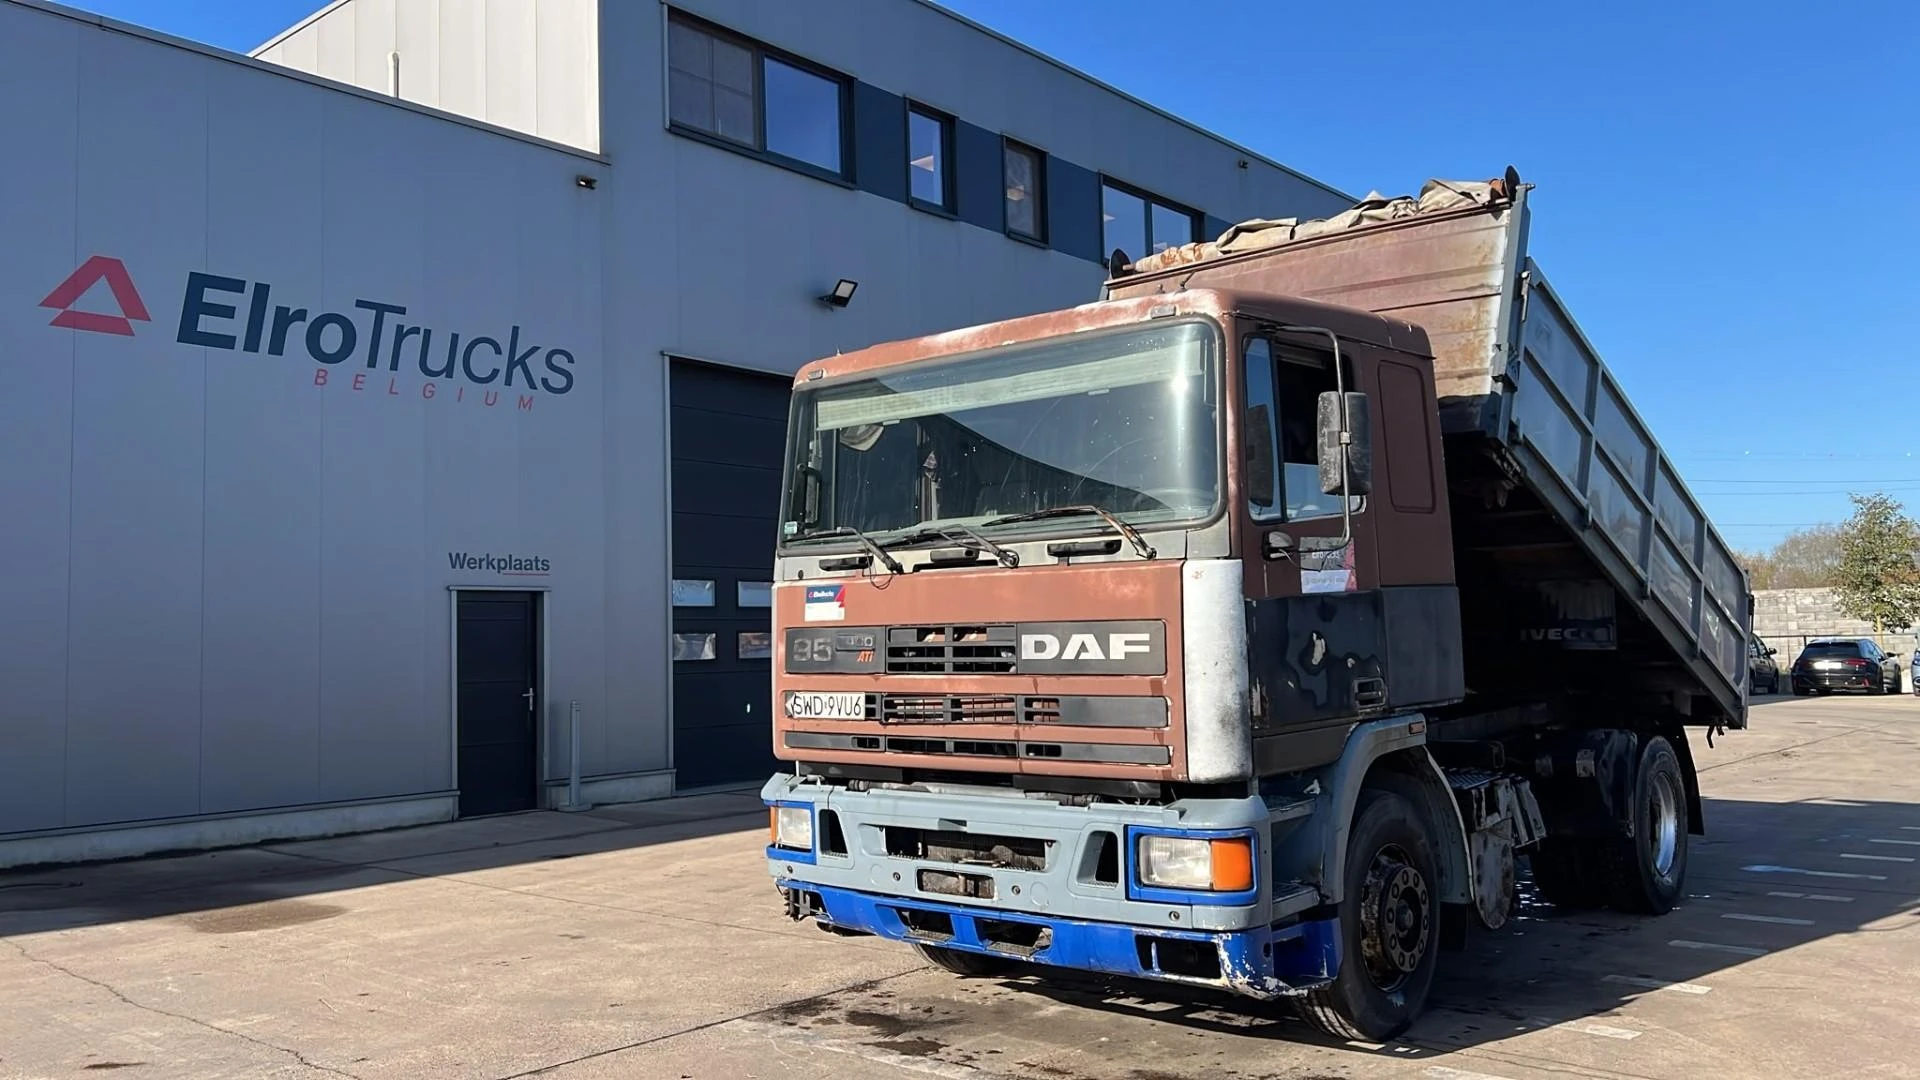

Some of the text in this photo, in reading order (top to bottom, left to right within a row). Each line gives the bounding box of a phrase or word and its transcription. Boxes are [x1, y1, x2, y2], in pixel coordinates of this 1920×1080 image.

[176, 271, 576, 394] ElroTrucks
[314, 368, 533, 411] BELGIUM
[448, 552, 550, 573] Werkplaats
[793, 638, 832, 661] 95
[1021, 633, 1150, 660] DAF
